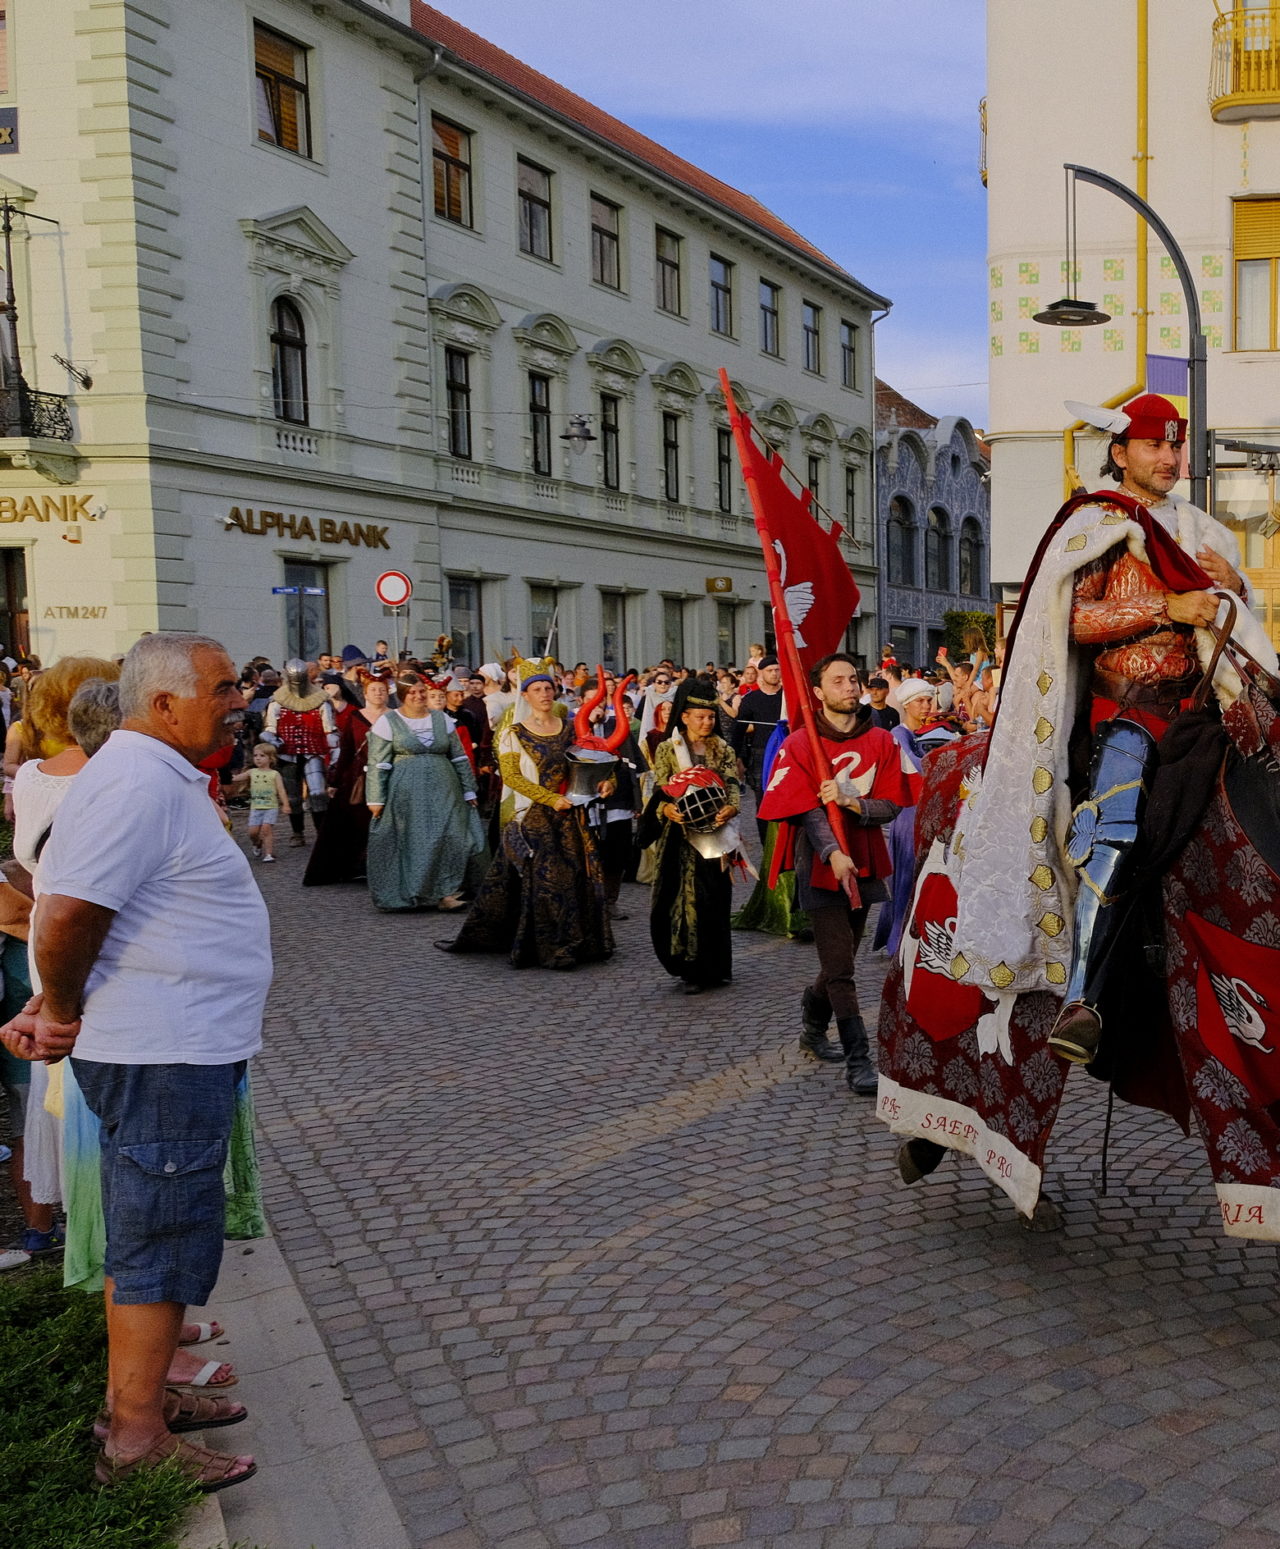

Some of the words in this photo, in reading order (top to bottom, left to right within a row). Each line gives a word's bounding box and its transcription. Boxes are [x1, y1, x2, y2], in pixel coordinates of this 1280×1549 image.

[0, 494, 96, 523] BANK
[224, 506, 316, 541] ALPHA
[319, 518, 390, 550] BANK
[43, 606, 79, 619] ATM
[81, 606, 108, 619] 24/7
[921, 1112, 979, 1145] SAEPE
[986, 1149, 1013, 1178] PRO
[1220, 1202, 1264, 1225] RIA
